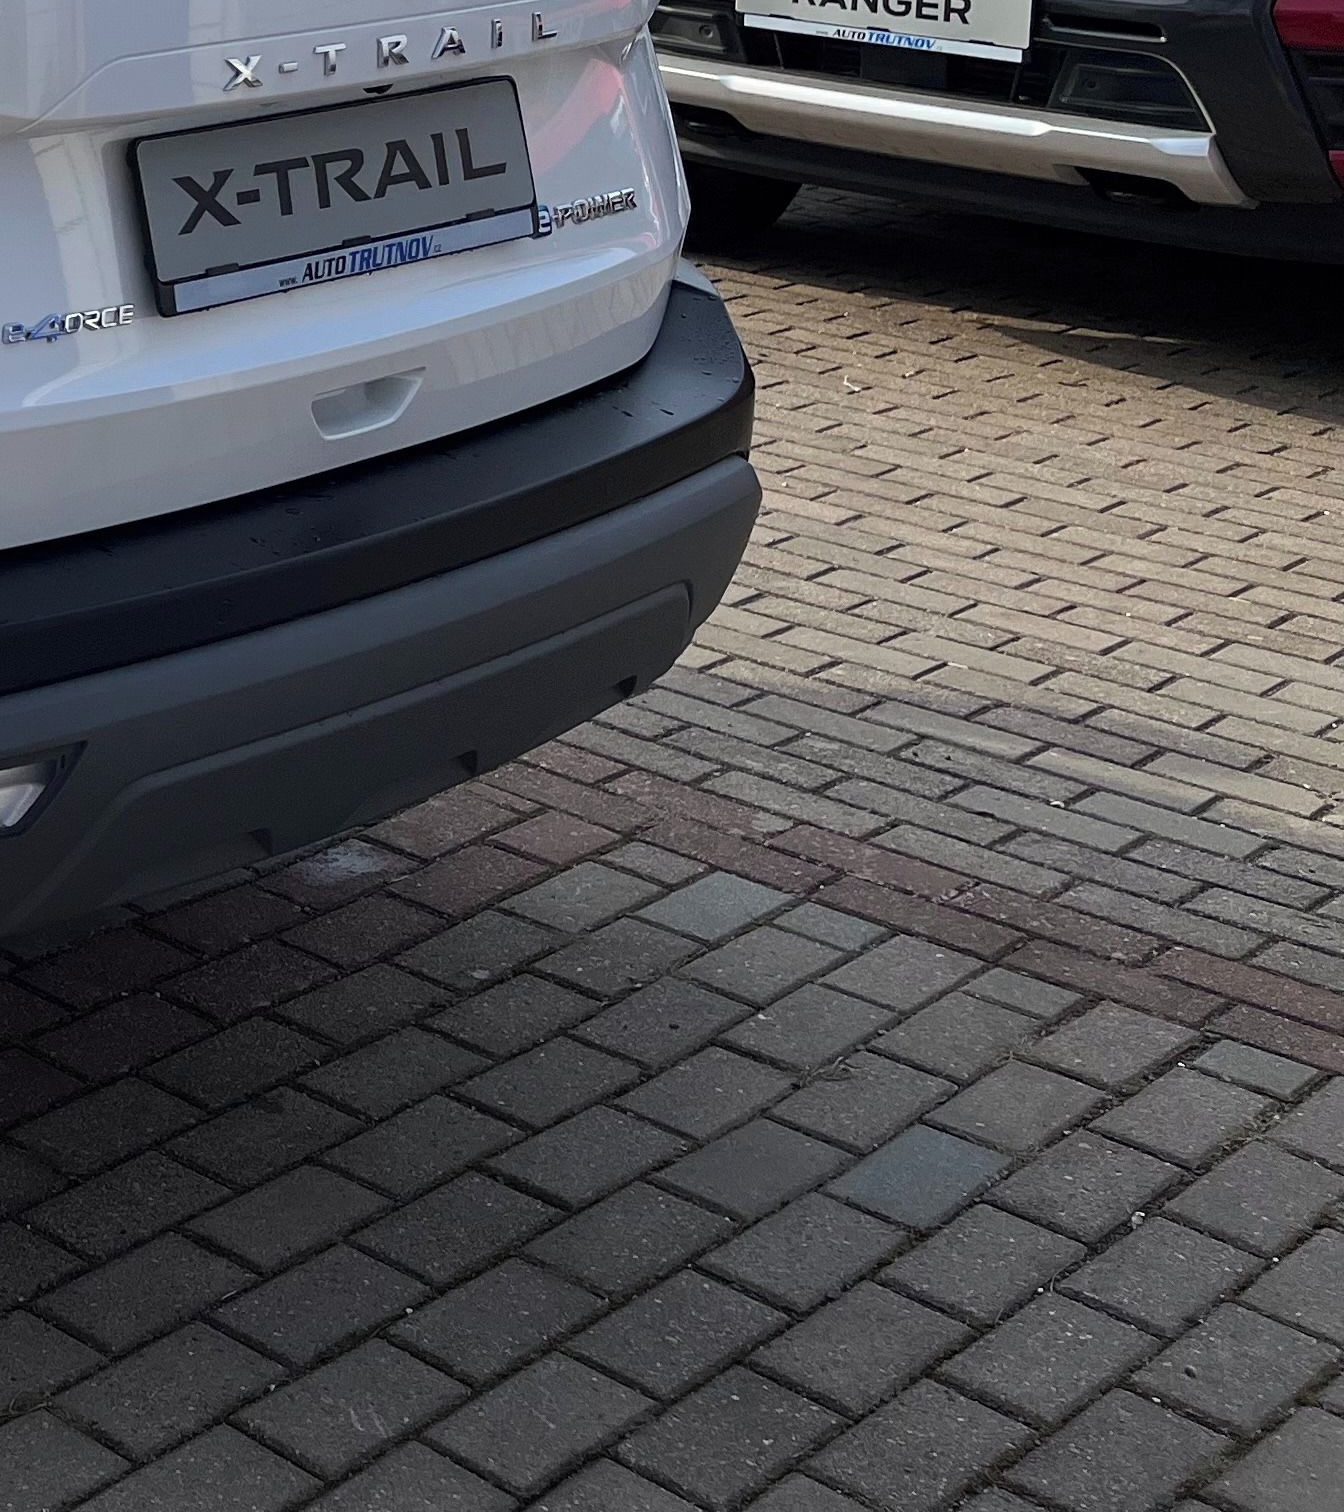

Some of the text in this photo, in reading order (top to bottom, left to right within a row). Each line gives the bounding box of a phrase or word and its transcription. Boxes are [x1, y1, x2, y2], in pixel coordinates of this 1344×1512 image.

[223, 11, 558, 92] X-TRAIL
[171, 127, 507, 236] X-TRAIL
[538, 187, 637, 234] e-POWER
